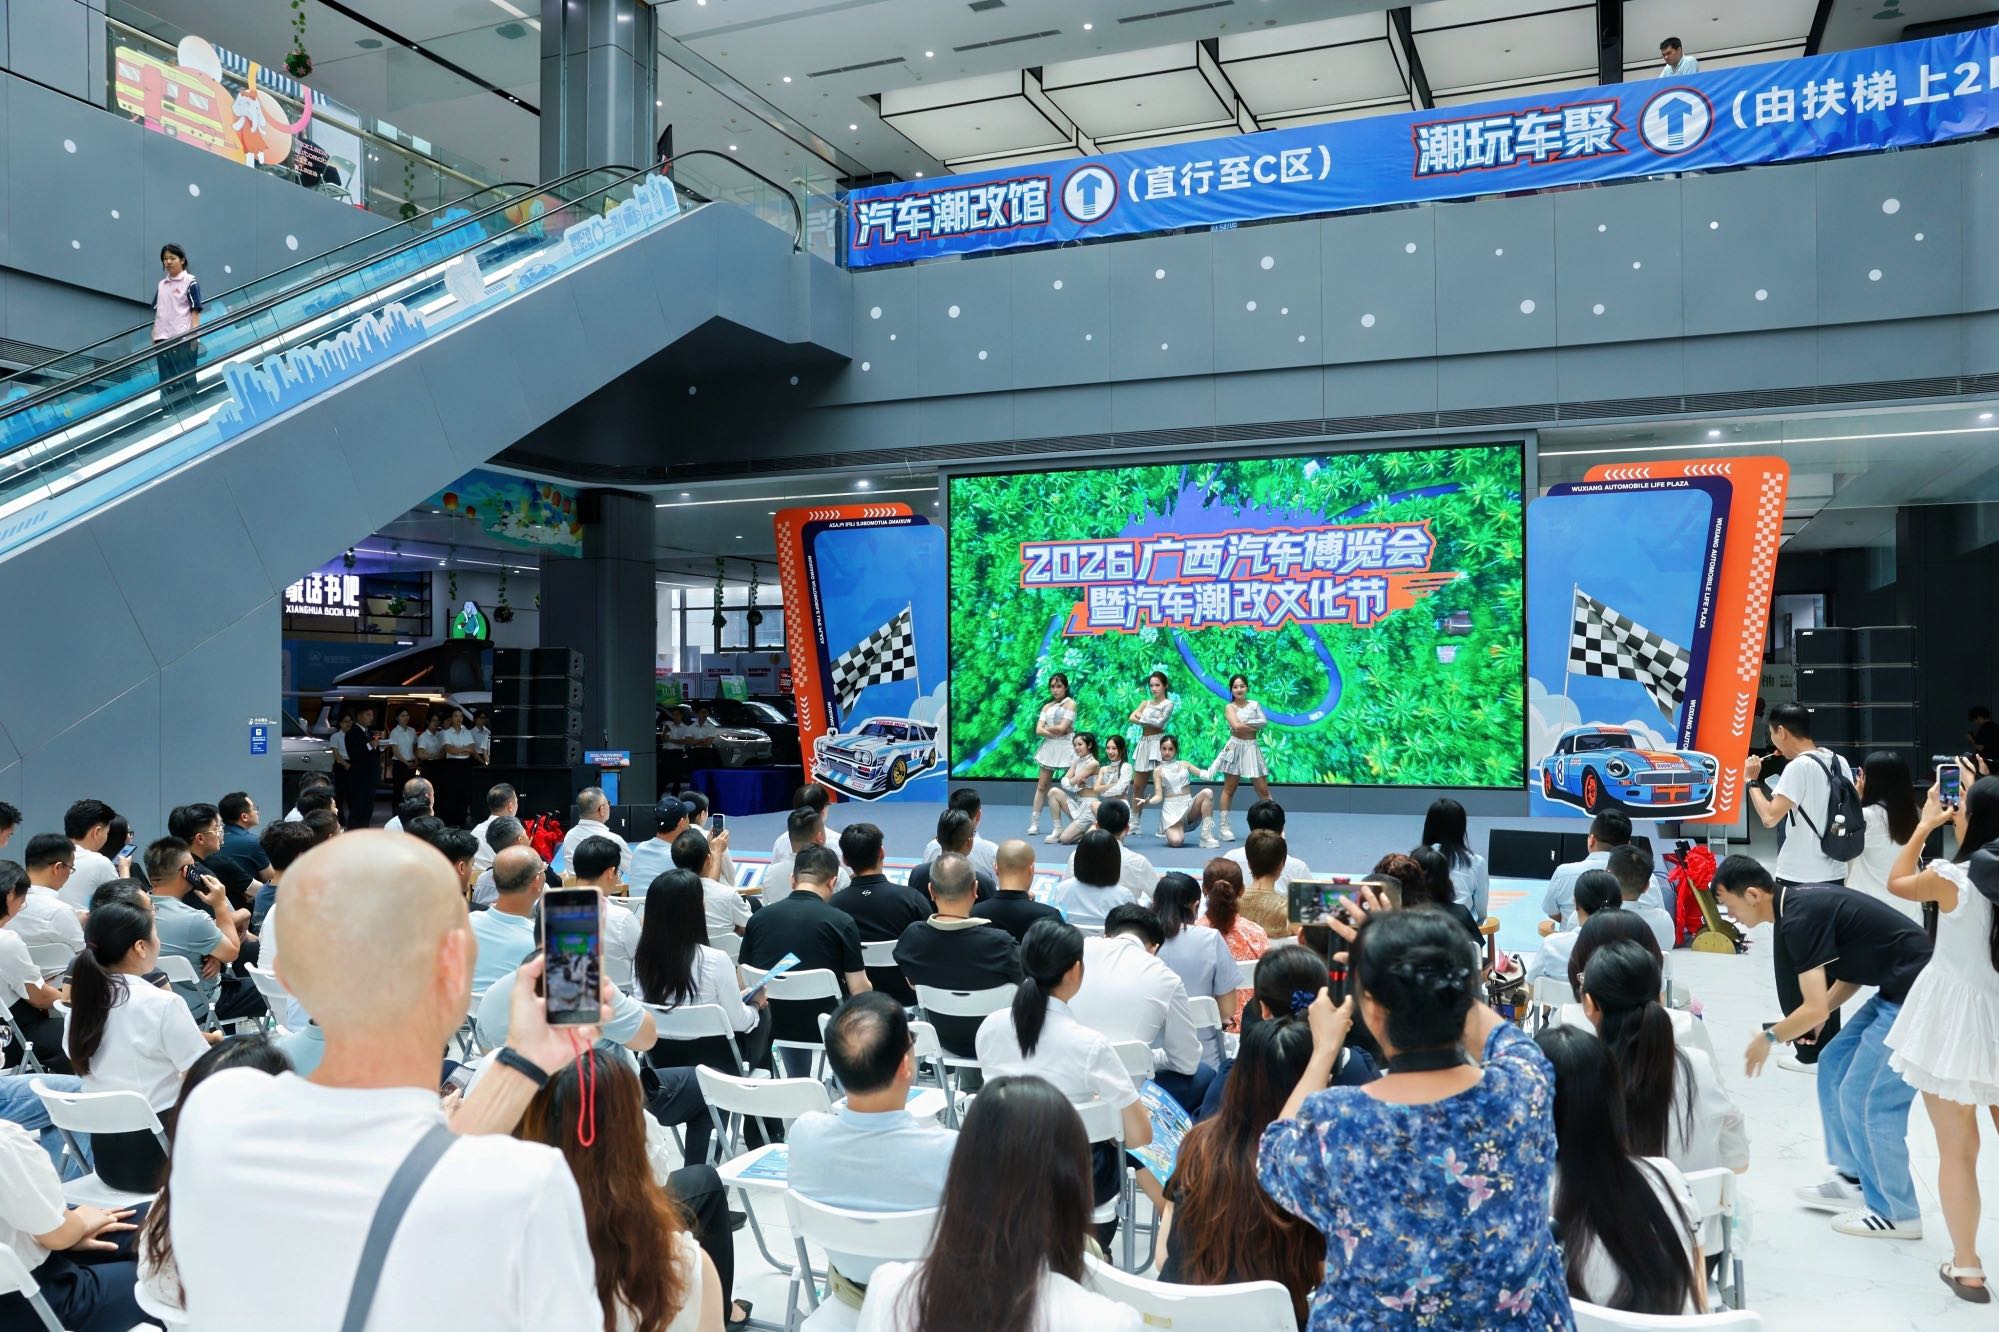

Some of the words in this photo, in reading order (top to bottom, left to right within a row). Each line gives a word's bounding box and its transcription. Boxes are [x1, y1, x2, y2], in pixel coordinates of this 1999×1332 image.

[1417, 101, 1618, 175] 潮玩车聚
[857, 180, 1047, 246] 汽车潮改馆
[1127, 144, 1332, 203] (直行至C区)
[1571, 484, 1603, 492] WUXIANG
[1604, 482, 1649, 490] AUTOMOBILE
[1713, 517, 1723, 548] WUXIANG
[1022, 527, 1431, 583] 2026广西汽车博览会
[1705, 548, 1718, 592] AUTOMOBILE
[286, 605, 322, 615] XIANGHUA
[324, 607, 344, 616] BOOK
[346, 608, 359, 617] BAR
[1088, 577, 1390, 629] 暨汽车潮改文化节
[1703, 592, 1711, 607] LIFE
[1699, 607, 1708, 629] PLAZA
[1685, 699, 1696, 730] WUXIANG
